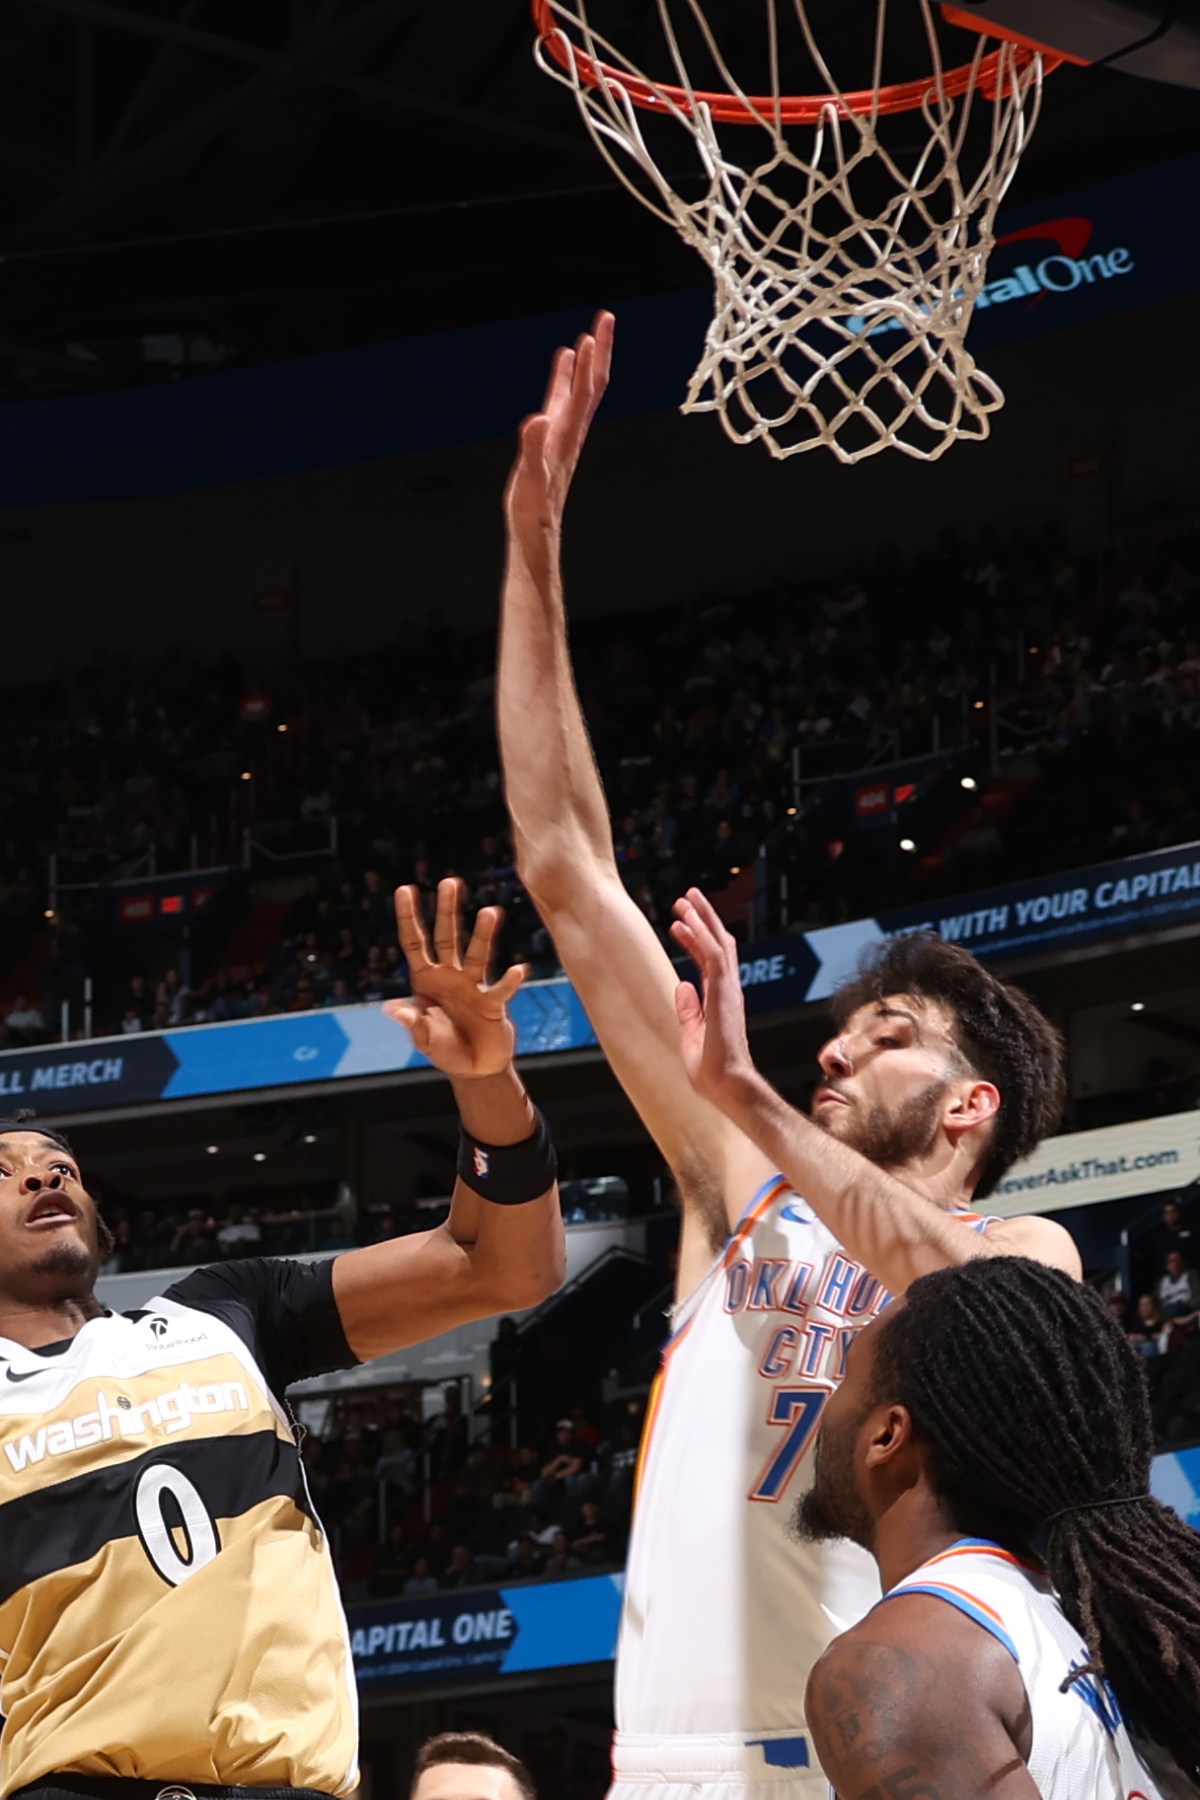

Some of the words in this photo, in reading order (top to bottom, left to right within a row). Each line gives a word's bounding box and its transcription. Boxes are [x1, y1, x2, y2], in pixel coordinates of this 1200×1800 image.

[939, 908, 1007, 944] WITH
[1014, 887, 1089, 926] YOUR
[30, 1056, 124, 1092] MERCH
[145, 1332, 209, 1351] Robinhood
[747, 1385, 837, 1503] 7
[132, 1458, 222, 1588] 0
[452, 1608, 512, 1645] ONE
